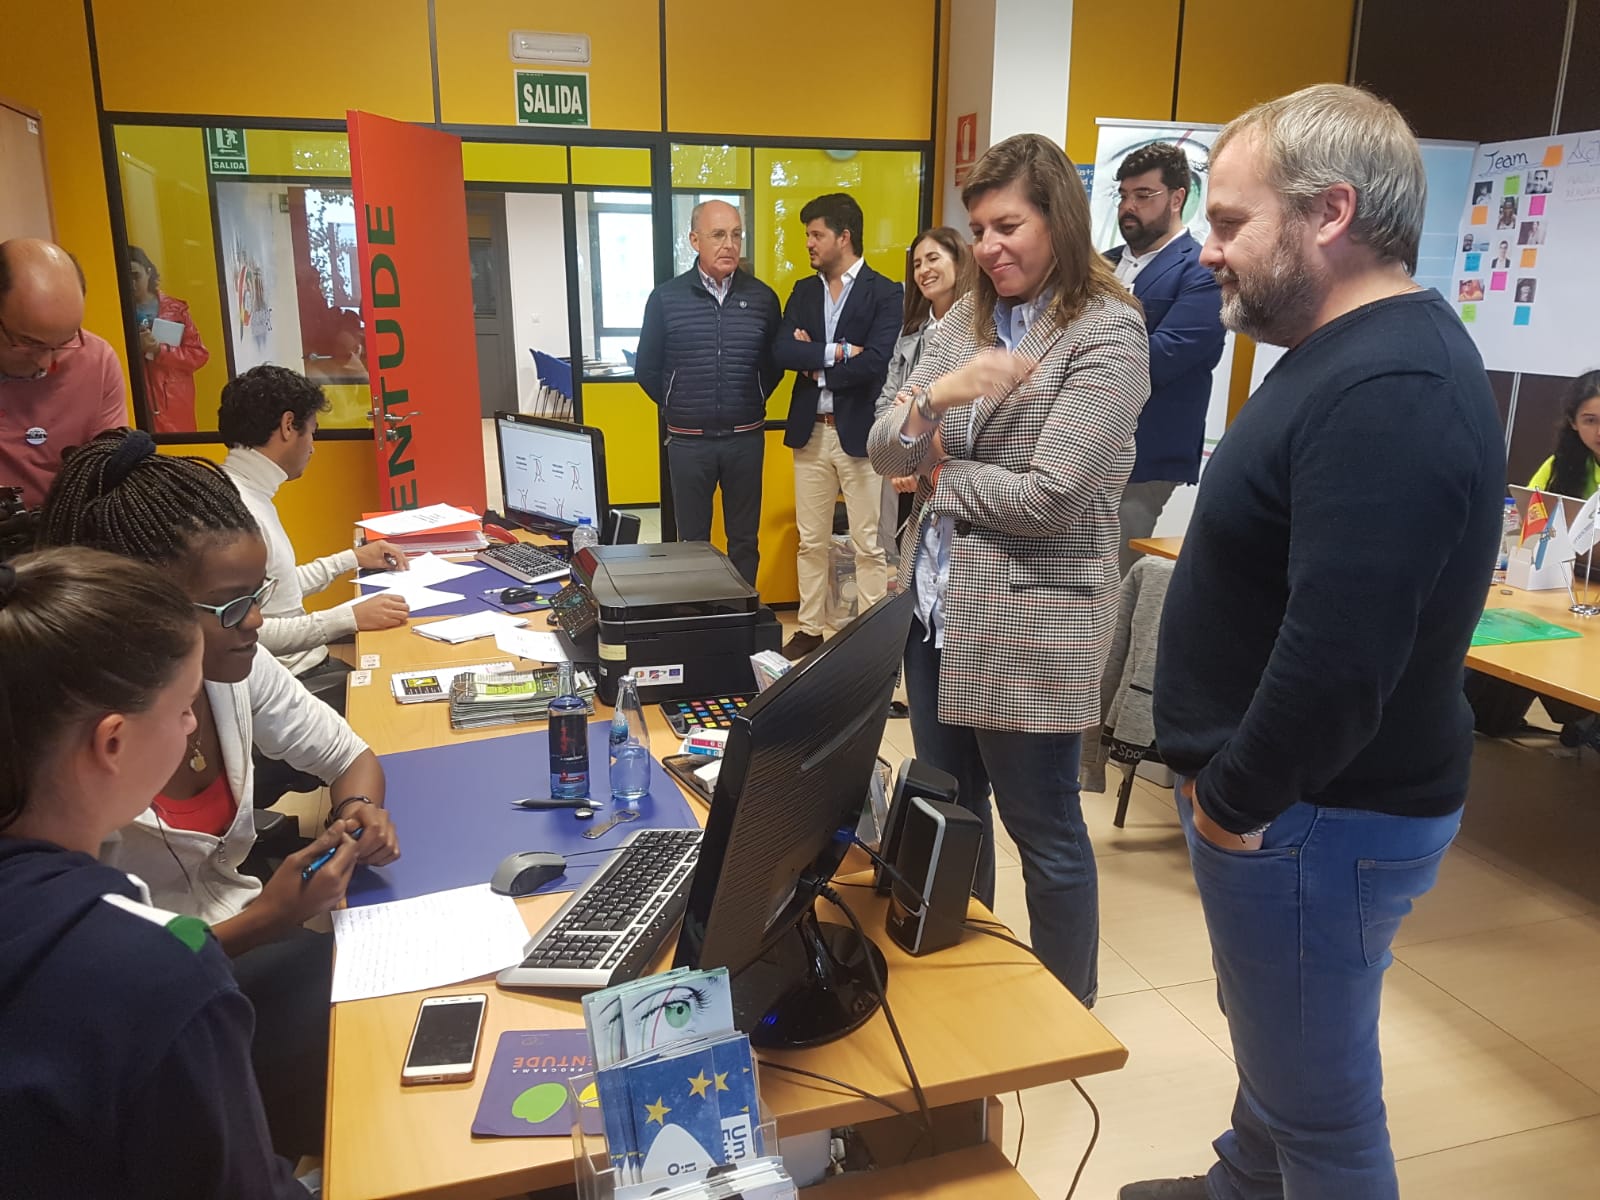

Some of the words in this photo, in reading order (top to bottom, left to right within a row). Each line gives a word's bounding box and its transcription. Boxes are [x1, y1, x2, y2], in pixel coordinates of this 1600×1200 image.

[523, 83, 583, 115] SALIDA
[213, 161, 245, 170] SALIDA
[1484, 151, 1529, 176] Team
[364, 203, 419, 512] ENTUDE
